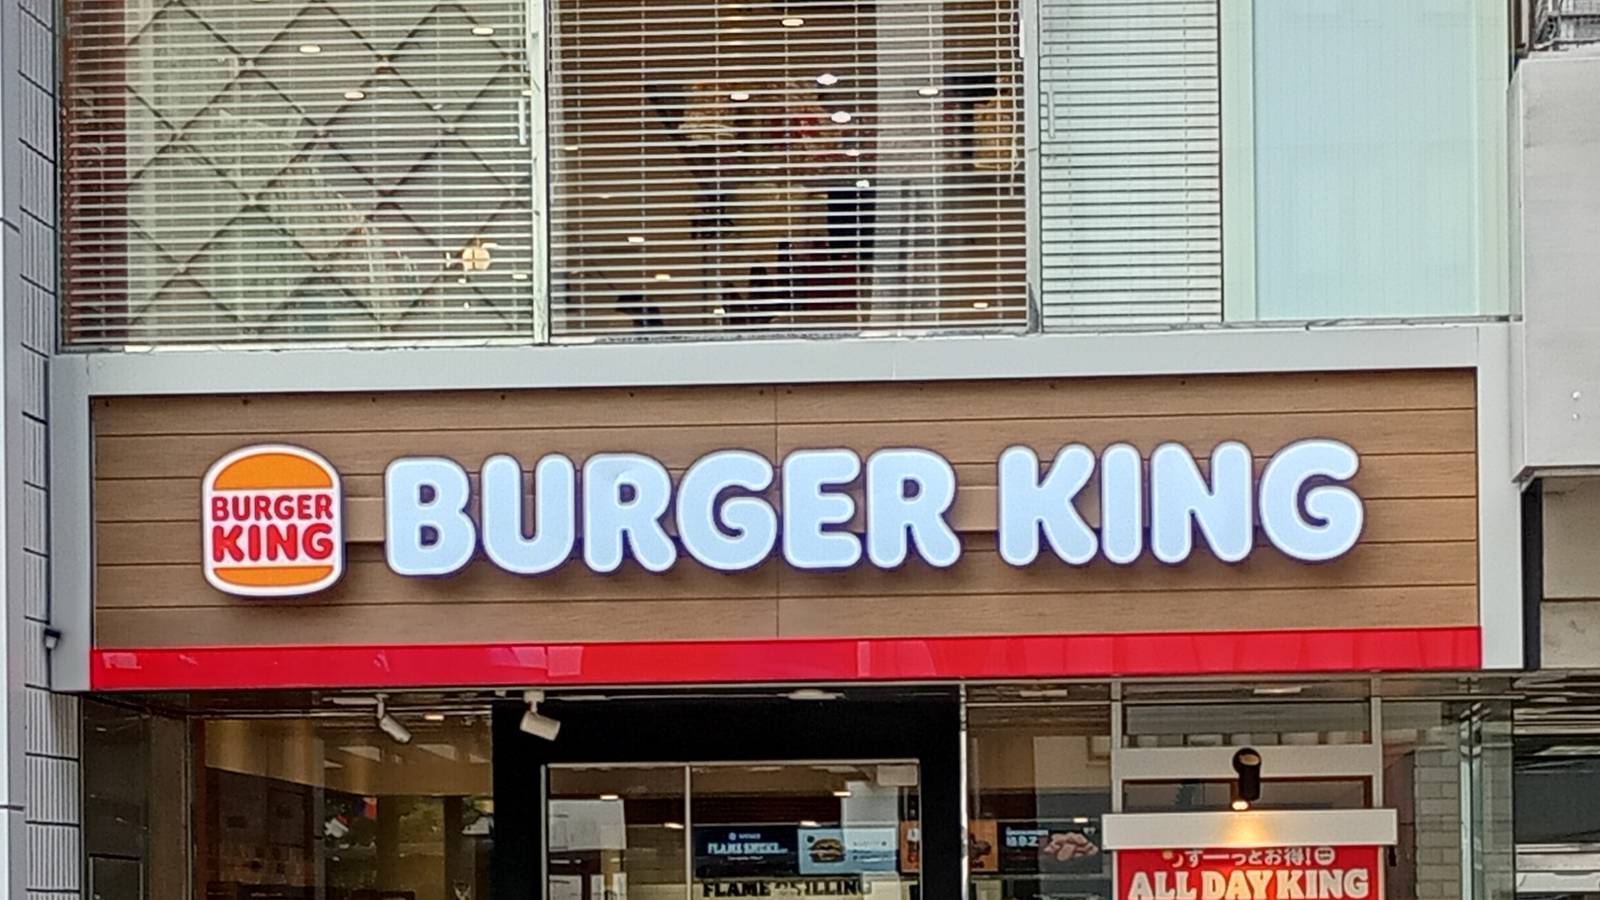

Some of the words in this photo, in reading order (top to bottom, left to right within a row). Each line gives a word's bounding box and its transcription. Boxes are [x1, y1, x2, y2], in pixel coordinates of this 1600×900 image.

[211, 493, 334, 522] BURGER
[385, 447, 961, 577] BURGER
[999, 439, 1364, 565] KING
[212, 522, 334, 563] KING
[703, 880, 771, 897] FLAME
[1127, 870, 1198, 900] ALL
